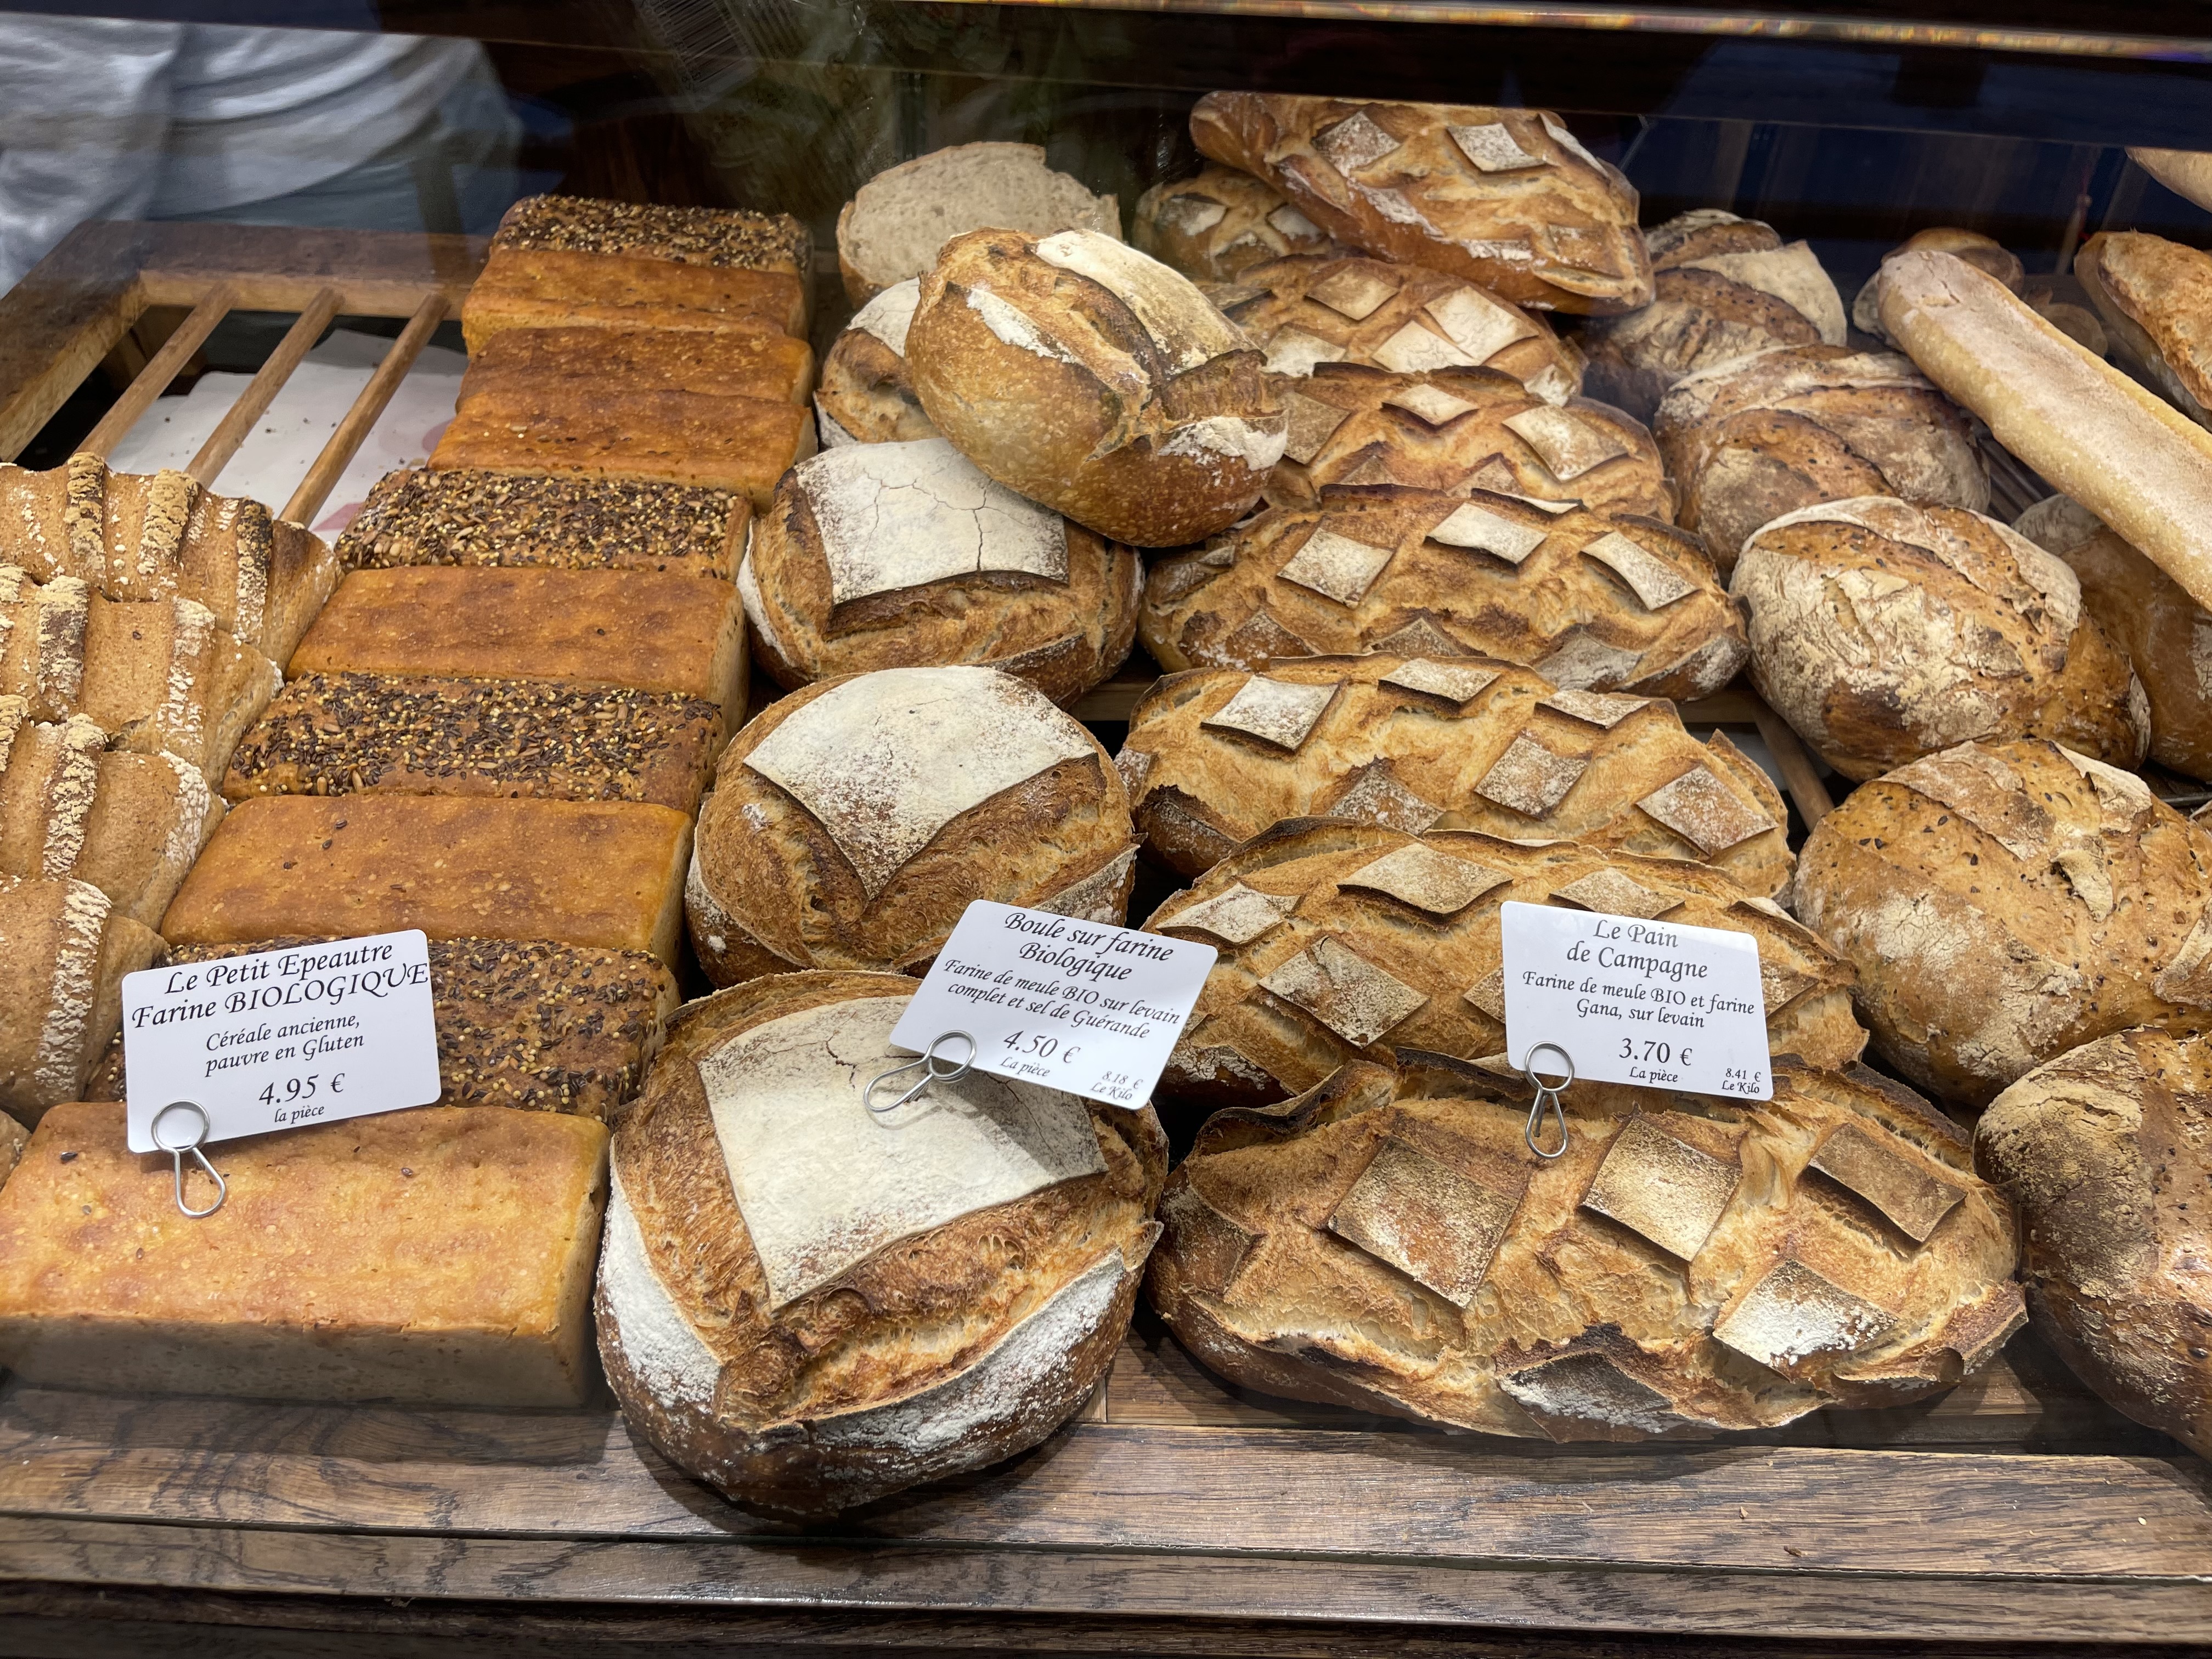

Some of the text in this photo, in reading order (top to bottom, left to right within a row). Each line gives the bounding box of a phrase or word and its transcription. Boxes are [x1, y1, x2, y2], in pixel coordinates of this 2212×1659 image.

[1005, 912, 1174, 961] Boule sur farine
[1593, 919, 1679, 948] Le Pain
[165, 944, 393, 995] Le Petit Epeautre
[1019, 942, 1133, 981] Biologique
[1567, 940, 1708, 982] de Campagne
[132, 963, 428, 1028] Farine BIOLOGIQUE
[943, 960, 1180, 1025] Farine de meule BIO sur levain
[1523, 971, 1755, 1015] Farine de meule BIO et farine
[948, 982, 1151, 1039] complet et sel de Guérande
[1577, 998, 1705, 1028] Gana, sur levain
[206, 1014, 360, 1051] Céréale ancienne,
[1004, 1030, 1081, 1064] 4.50 €
[205, 1034, 364, 1077] pauvre en Gluten
[1000, 1056, 1051, 1079] La pièce
[1619, 1037, 1692, 1066] 3.70 €
[258, 1073, 345, 1105] 4.95 €
[1090, 1081, 1133, 1101] Le Kilo
[1101, 1071, 1143, 1090] 8.18 €
[1629, 1066, 1678, 1083] La pièce
[1722, 1080, 1759, 1094] Le Kilo
[1725, 1068, 1761, 1082] 8.41 €
[274, 1105, 325, 1124] la pièce
